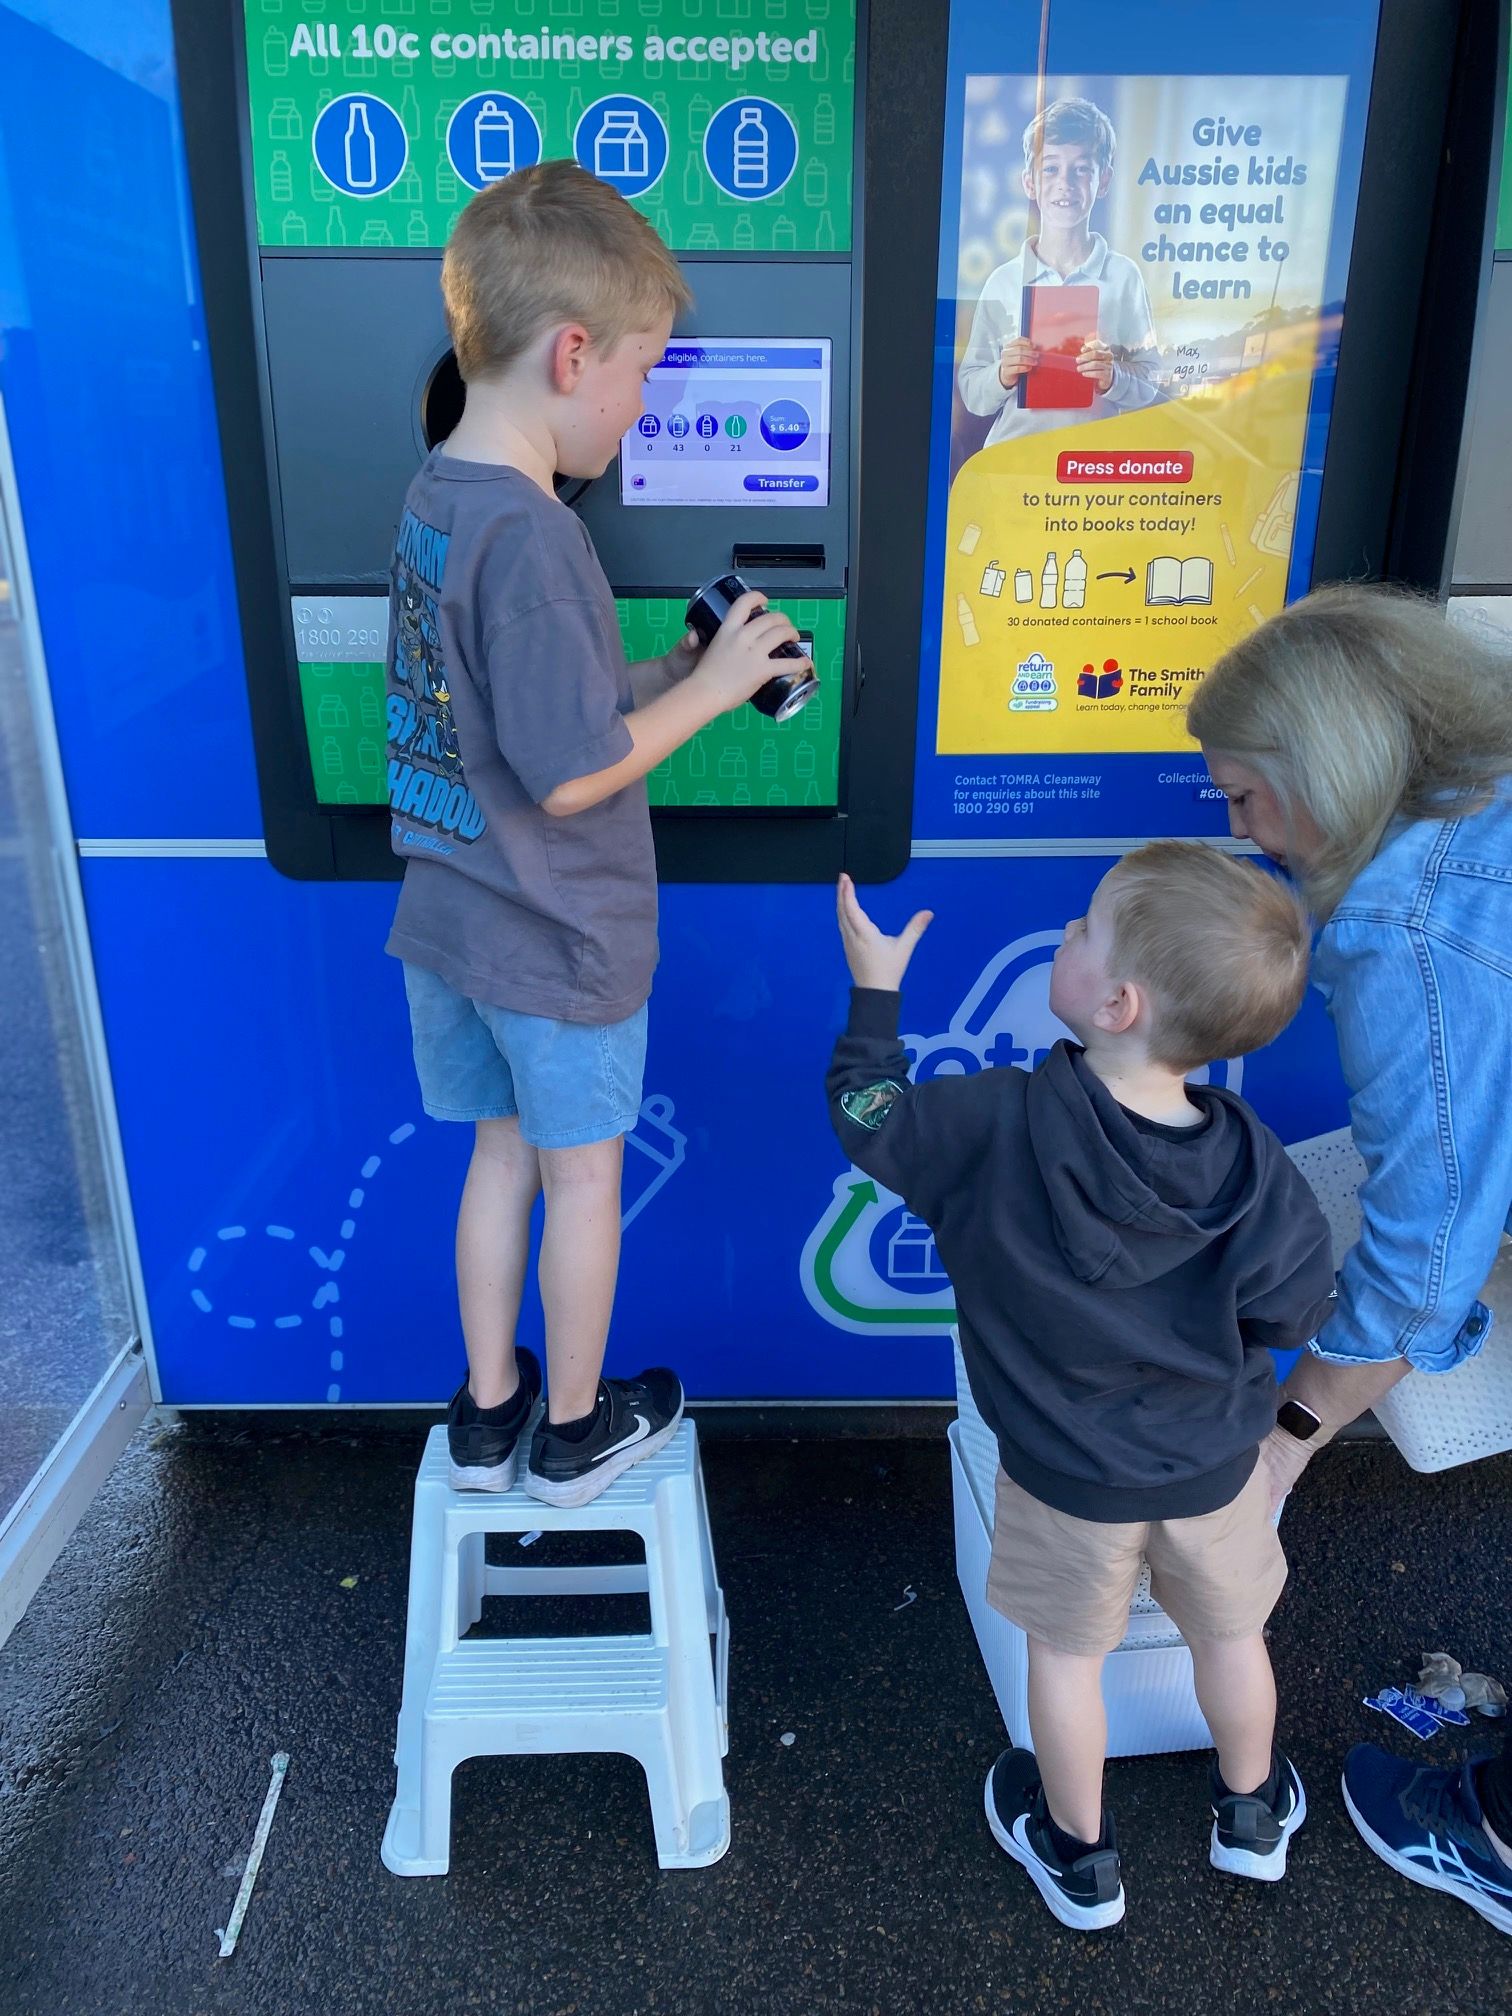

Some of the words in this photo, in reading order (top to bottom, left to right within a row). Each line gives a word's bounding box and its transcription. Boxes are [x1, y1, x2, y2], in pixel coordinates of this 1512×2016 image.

[290, 23, 341, 58] All
[352, 25, 420, 59] 10c
[431, 27, 633, 60] containers
[644, 30, 818, 70] accepted
[1192, 117, 1263, 146] Give
[1138, 156, 1240, 186] Aussie
[1247, 156, 1307, 186] kids
[1153, 204, 1192, 225] an
[1200, 195, 1284, 232] equal
[1141, 234, 1249, 263] chance
[1258, 236, 1290, 263] to
[1172, 272, 1252, 300] learn
[667, 353, 698, 363] eligible
[700, 353, 745, 362] containers
[1176, 345, 1200, 359] Max,
[1174, 365, 1195, 379] age
[1197, 364, 1208, 374] 10
[778, 423, 800, 432] 6.40
[647, 444, 653, 452] 0
[672, 444, 684, 452] 43
[704, 444, 710, 452] 0
[730, 444, 742, 452] 21
[1067, 460, 1114, 476] Press
[1119, 461, 1183, 476] donate
[758, 478, 806, 488] Transfer
[1023, 493, 1040, 507] to
[1045, 494, 1081, 507] turn
[1085, 494, 1124, 510] your
[1129, 492, 1223, 507] containers
[1045, 517, 1078, 532] into
[1083, 517, 1134, 532] books
[1139, 517, 1196, 535] today!
[1007, 617, 1020, 627] 30
[1022, 616, 1070, 627] donated
[1072, 616, 1132, 626] containers
[1144, 616, 1149, 626] 1
[1151, 615, 1189, 626] school
[1190, 615, 1218, 626] book
[298, 629, 341, 646] 1800
[347, 629, 379, 646] 290
[1018, 662, 1053, 672] return
[1129, 669, 1156, 682] The
[1160, 667, 1205, 681] Smith
[1130, 683, 1183, 700] Family
[1076, 703, 1099, 712] Learn
[1100, 703, 1127, 713] today,
[1128, 703, 1160, 713] change
[955, 775, 997, 786] Contact
[1000, 774, 1041, 785] TOMRA
[1044, 774, 1102, 787] Cleanaway
[1158, 772, 1213, 784] Collection
[388, 759, 487, 843] HADOW
[954, 789, 970, 800] for
[972, 789, 1021, 801] enquiries
[1024, 788, 1056, 800] about
[1058, 788, 1079, 799] this
[1081, 788, 1101, 799] site
[953, 802, 983, 814] 1800
[986, 802, 1010, 814] 290
[1013, 802, 1034, 814] 691
